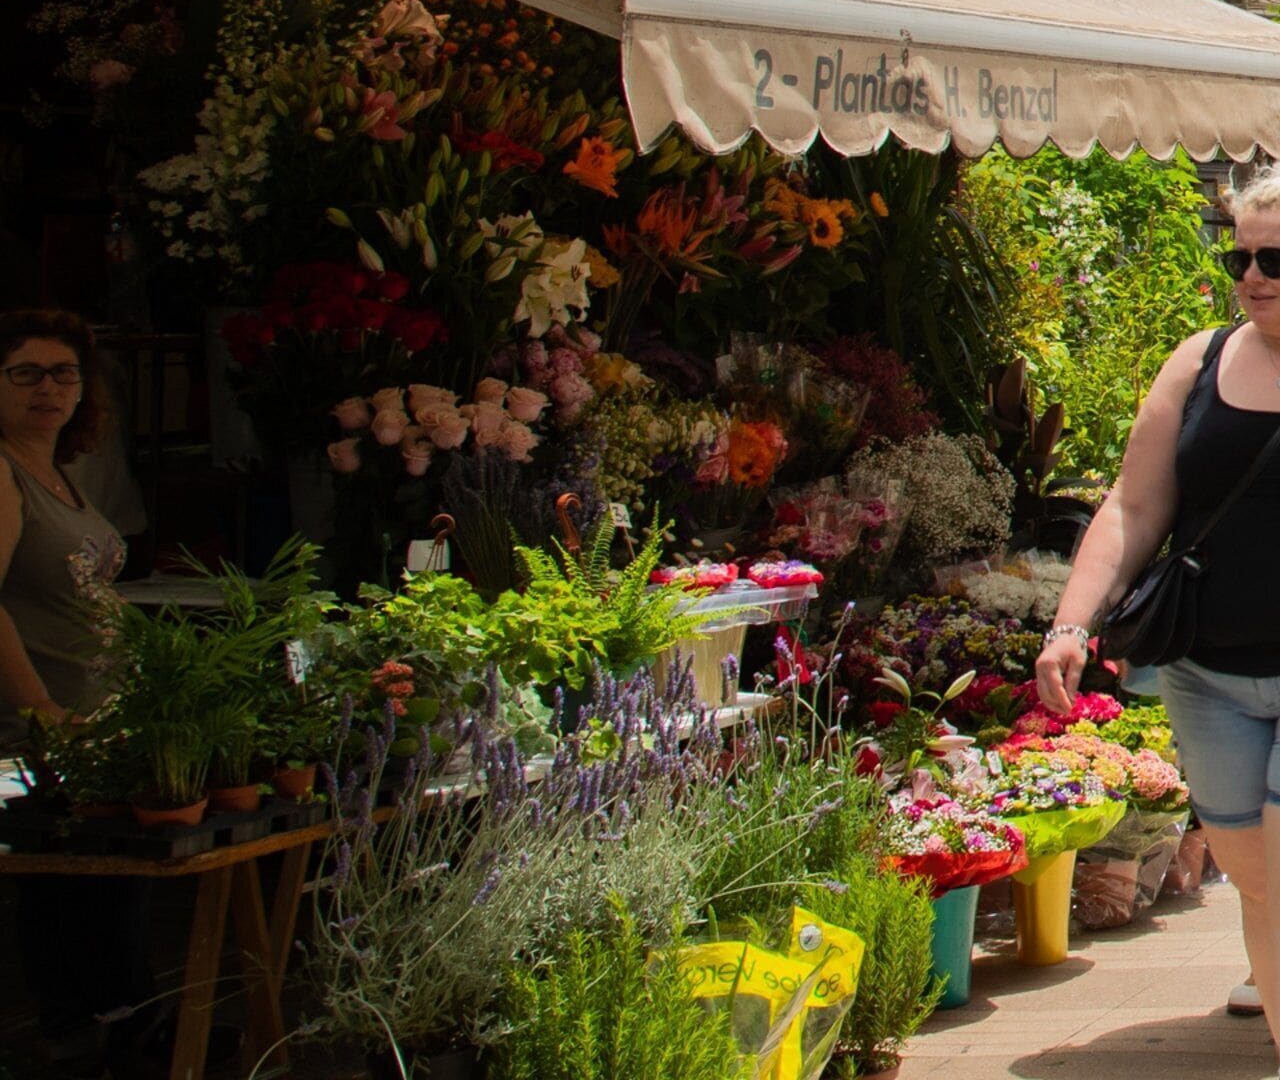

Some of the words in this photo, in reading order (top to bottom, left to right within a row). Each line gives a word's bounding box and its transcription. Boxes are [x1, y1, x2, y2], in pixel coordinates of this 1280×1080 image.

[754, 49, 775, 108] 2
[813, 47, 930, 116] Plantas
[944, 65, 967, 118] H.
[978, 68, 1058, 123] Benzal
